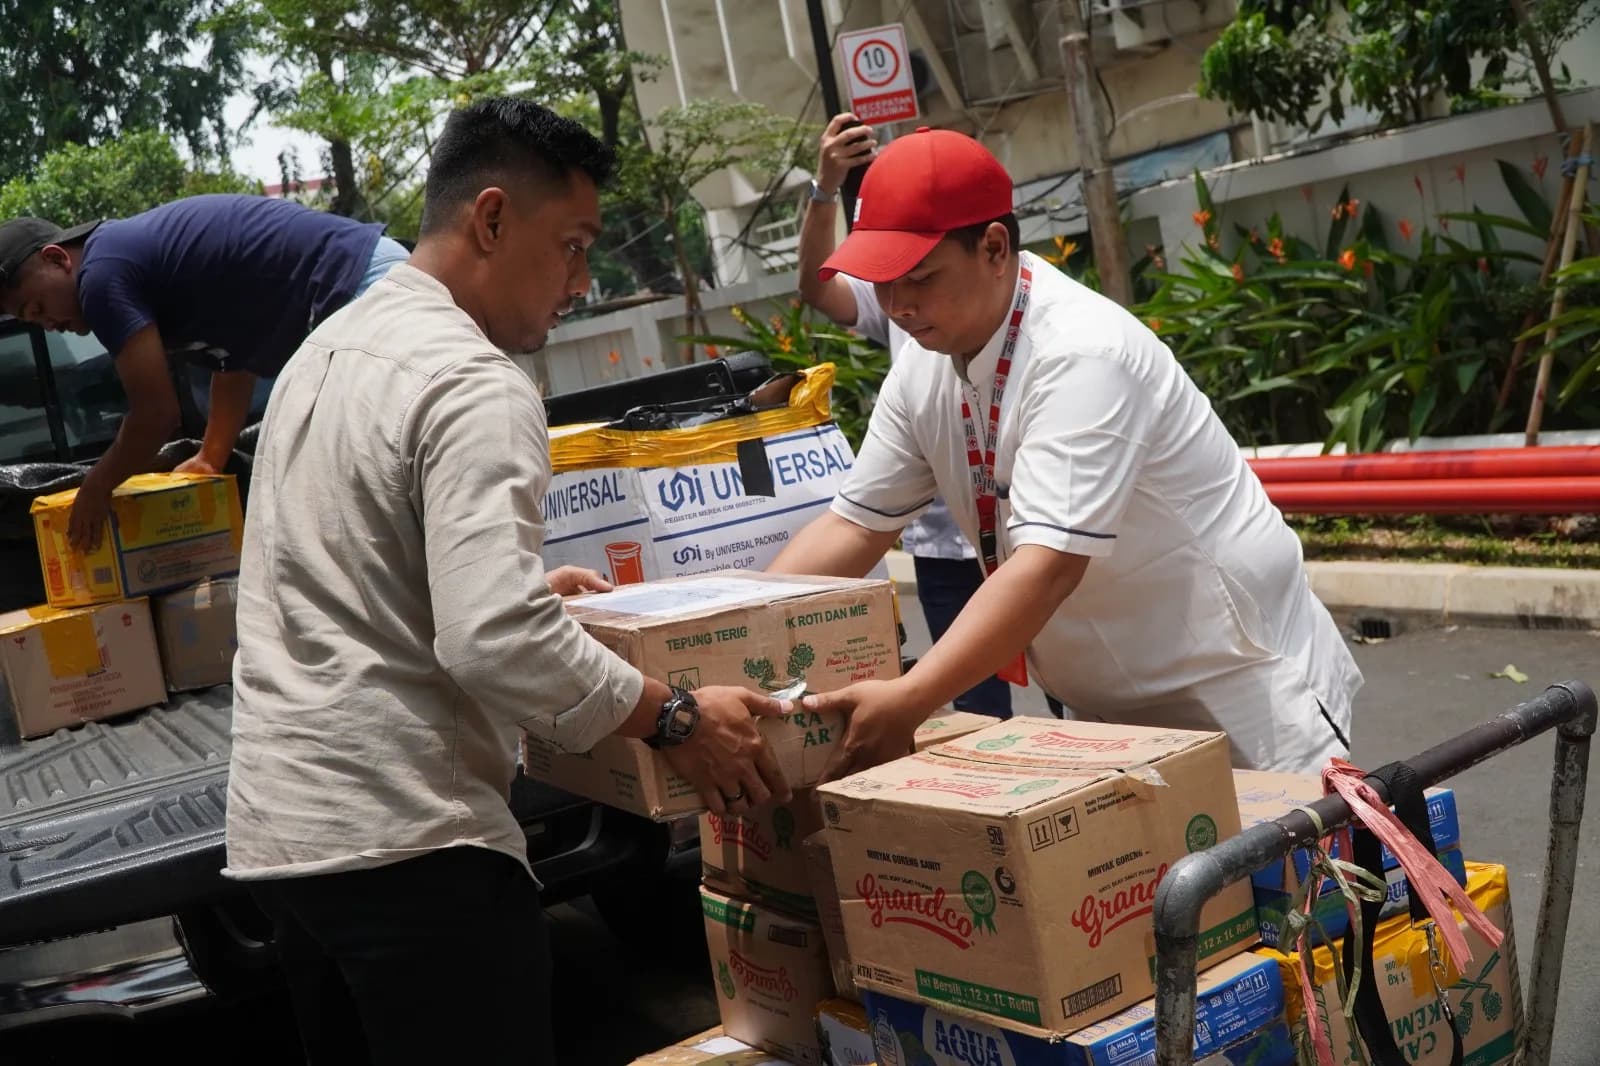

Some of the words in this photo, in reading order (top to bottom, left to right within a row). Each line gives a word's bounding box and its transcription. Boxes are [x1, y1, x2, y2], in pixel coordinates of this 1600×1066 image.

[863, 47, 885, 70] 10
[710, 444, 852, 500] UNERSAL
[664, 513, 697, 525] REGISTER
[704, 549, 714, 560] By
[715, 539, 754, 557] UNIVERSAL
[754, 530, 789, 547] PACKINDO
[733, 556, 755, 569] CUP
[665, 632, 712, 652] TEPUNG
[714, 626, 748, 642] TERIG
[798, 613, 823, 627] ROTI
[825, 607, 847, 622] DAN
[849, 604, 868, 617] MIE
[784, 712, 823, 728] RA
[1087, 860, 1114, 878] MINYAK
[1386, 880, 1409, 902] QUA
[856, 873, 972, 938] Grandco
[1072, 863, 1168, 948] Grand
[1203, 937, 1215, 950] 12
[1216, 935, 1222, 943] x
[857, 964, 872, 979] KTN
[1387, 974, 1399, 986] kg
[919, 974, 931, 987] Isi
[932, 976, 961, 995] Bersih
[969, 987, 982, 1001] 12
[984, 992, 990, 1002] x
[993, 993, 1005, 1007] 1L
[1008, 995, 1036, 1014] Refill
[1389, 1000, 1441, 1040] KEM
[935, 1019, 1003, 1066] AQUA
[1116, 1036, 1136, 1049] HALAL
[1217, 1028, 1226, 1038] 24
[1400, 1031, 1437, 1062] CA
